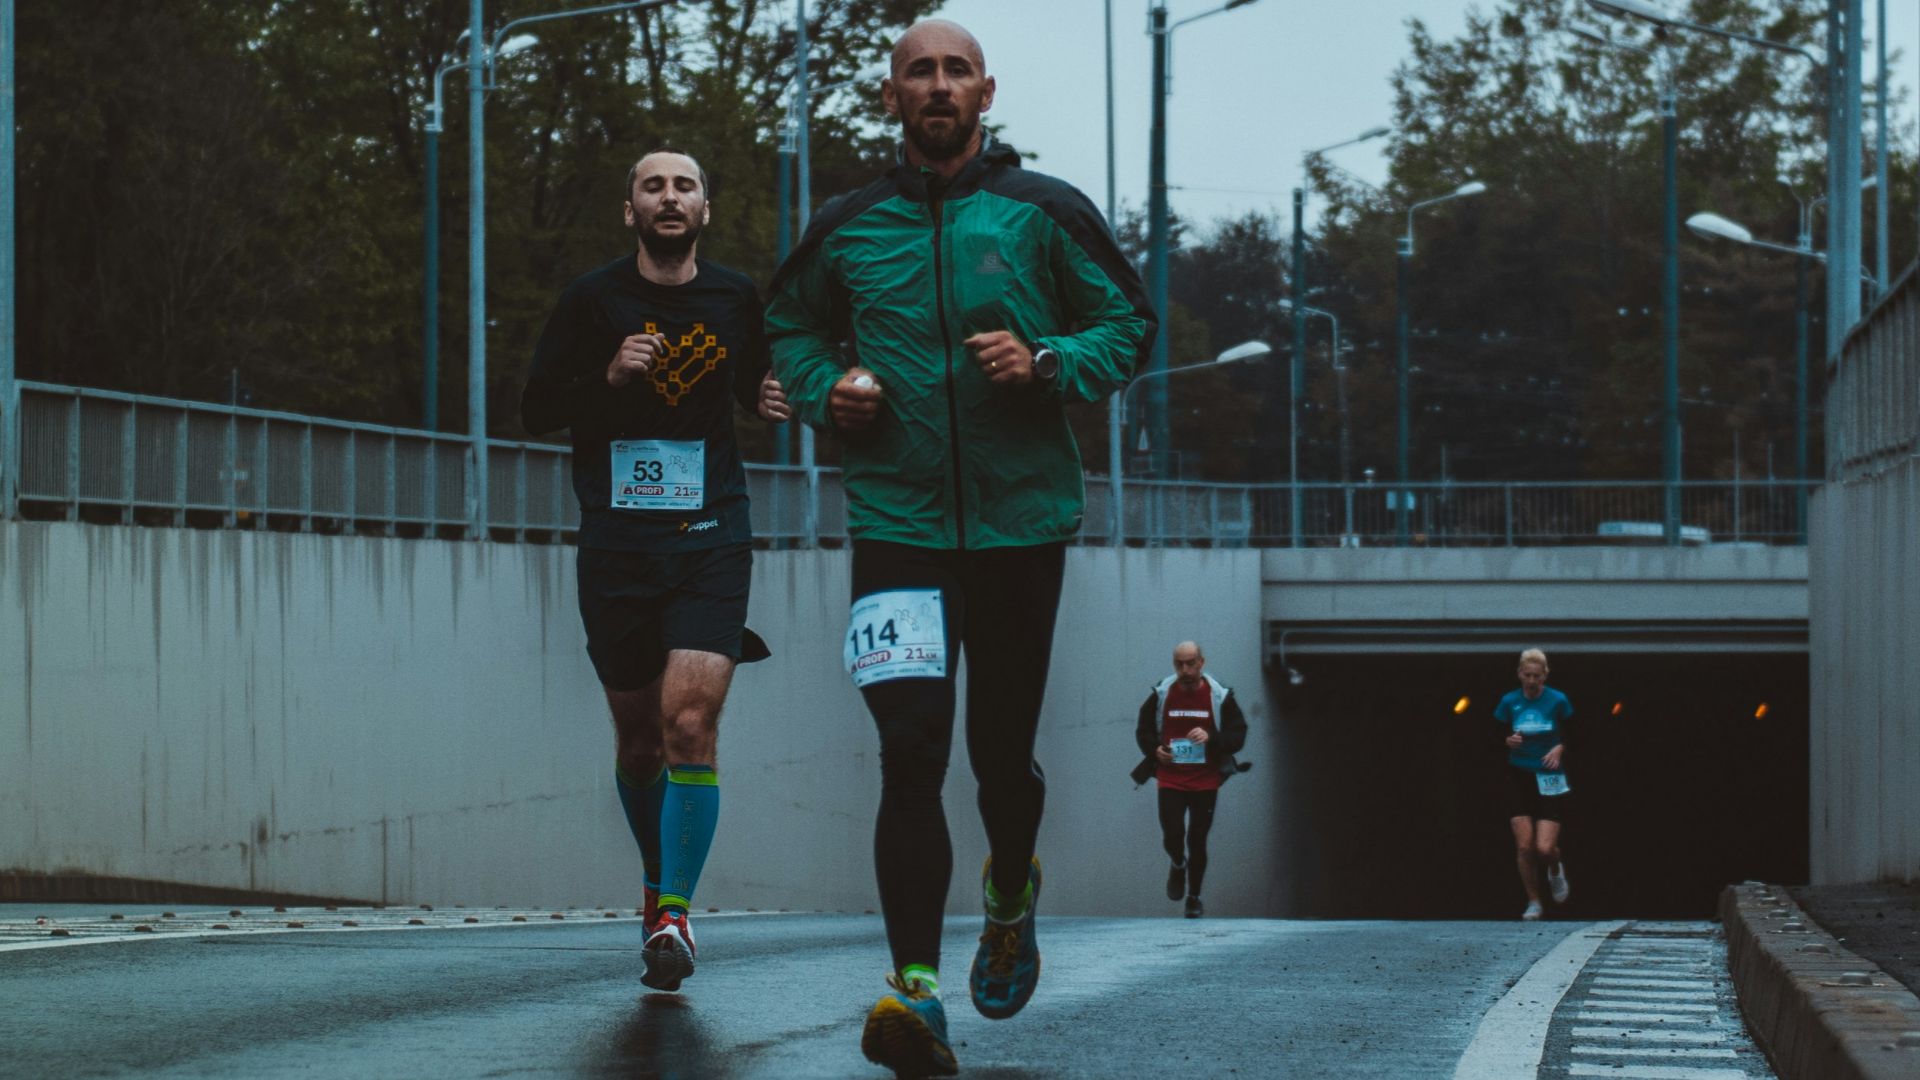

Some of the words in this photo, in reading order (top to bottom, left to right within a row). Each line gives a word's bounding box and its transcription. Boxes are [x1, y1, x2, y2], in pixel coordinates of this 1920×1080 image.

[633, 460, 663, 482] 53
[636, 486, 662, 495] PROFI
[850, 619, 899, 656] 114
[859, 652, 889, 668] PROFI
